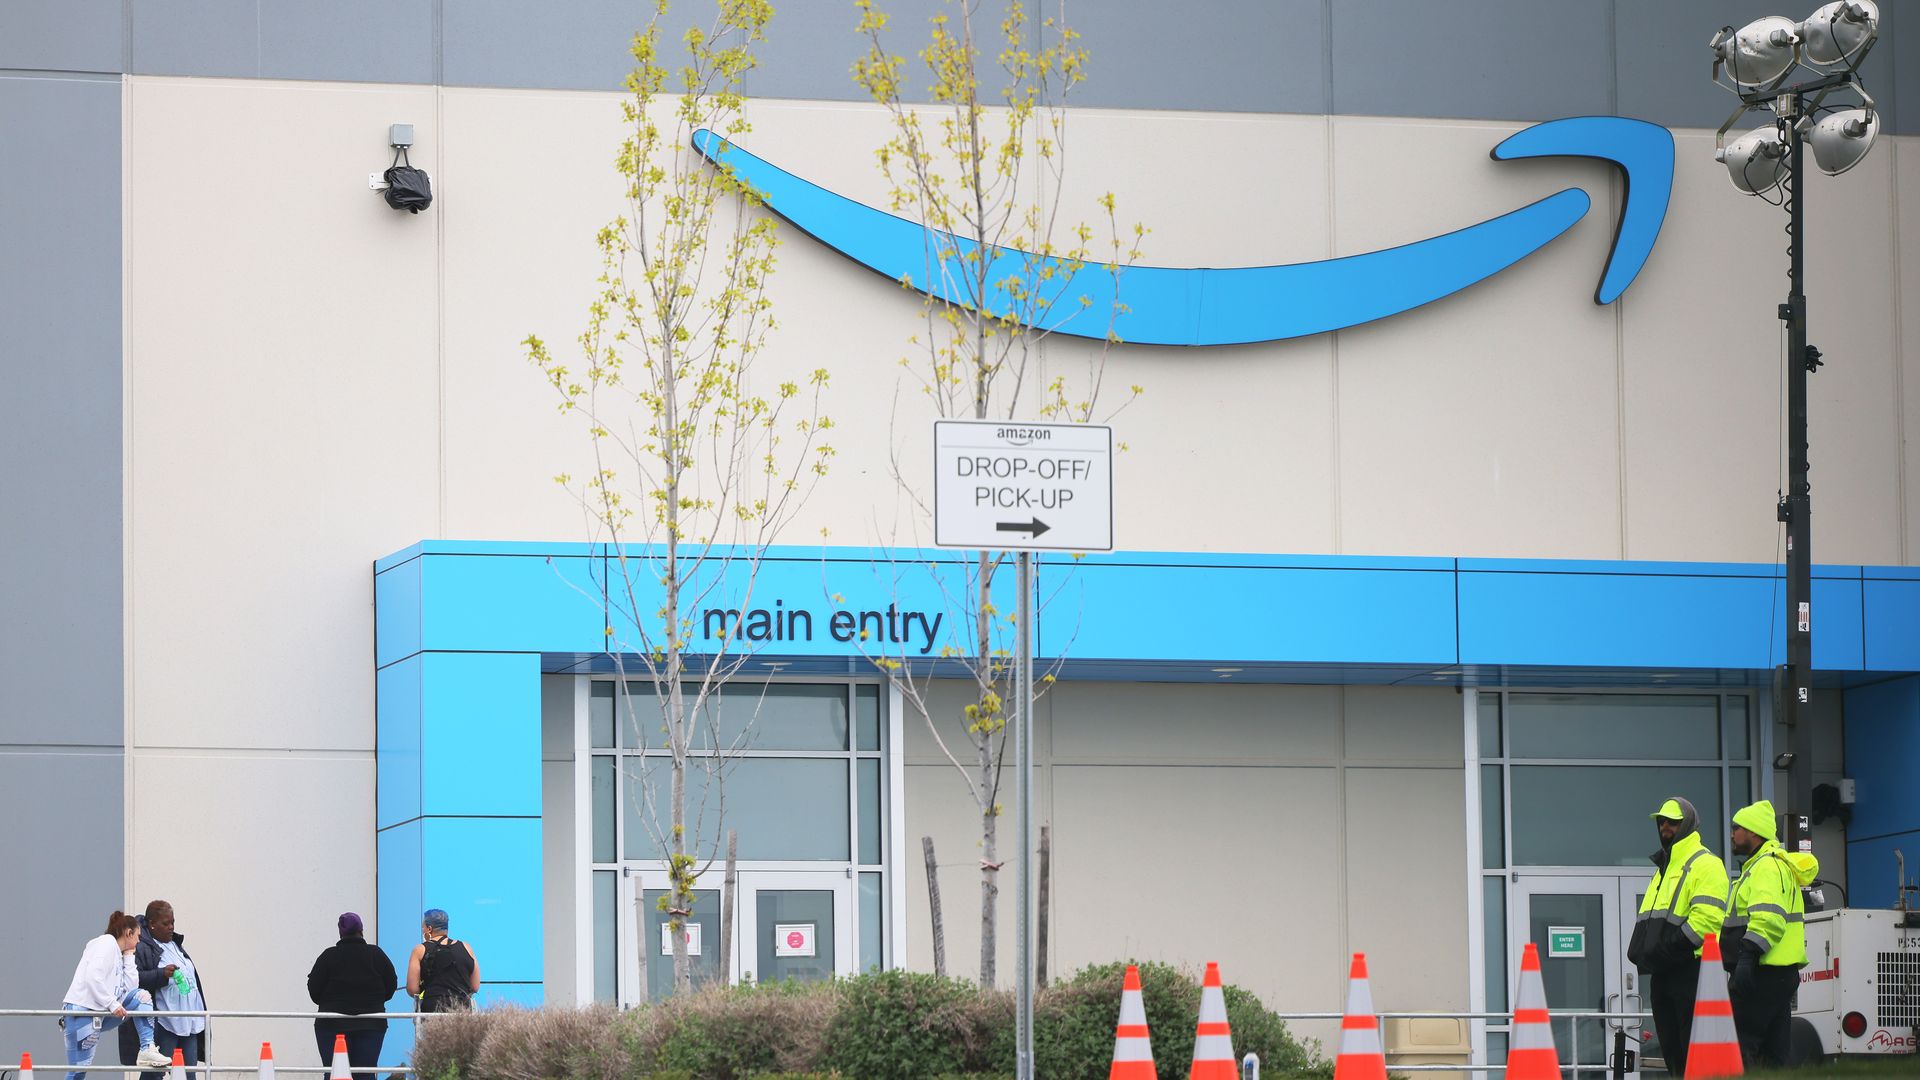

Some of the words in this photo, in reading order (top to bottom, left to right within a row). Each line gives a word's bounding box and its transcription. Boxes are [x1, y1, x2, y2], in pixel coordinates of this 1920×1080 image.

[997, 428, 1051, 440] amazon
[957, 456, 1092, 481] DROP-OFF/
[975, 486, 1074, 509] PICK-UP
[703, 599, 812, 641] main
[829, 602, 943, 654] entry
